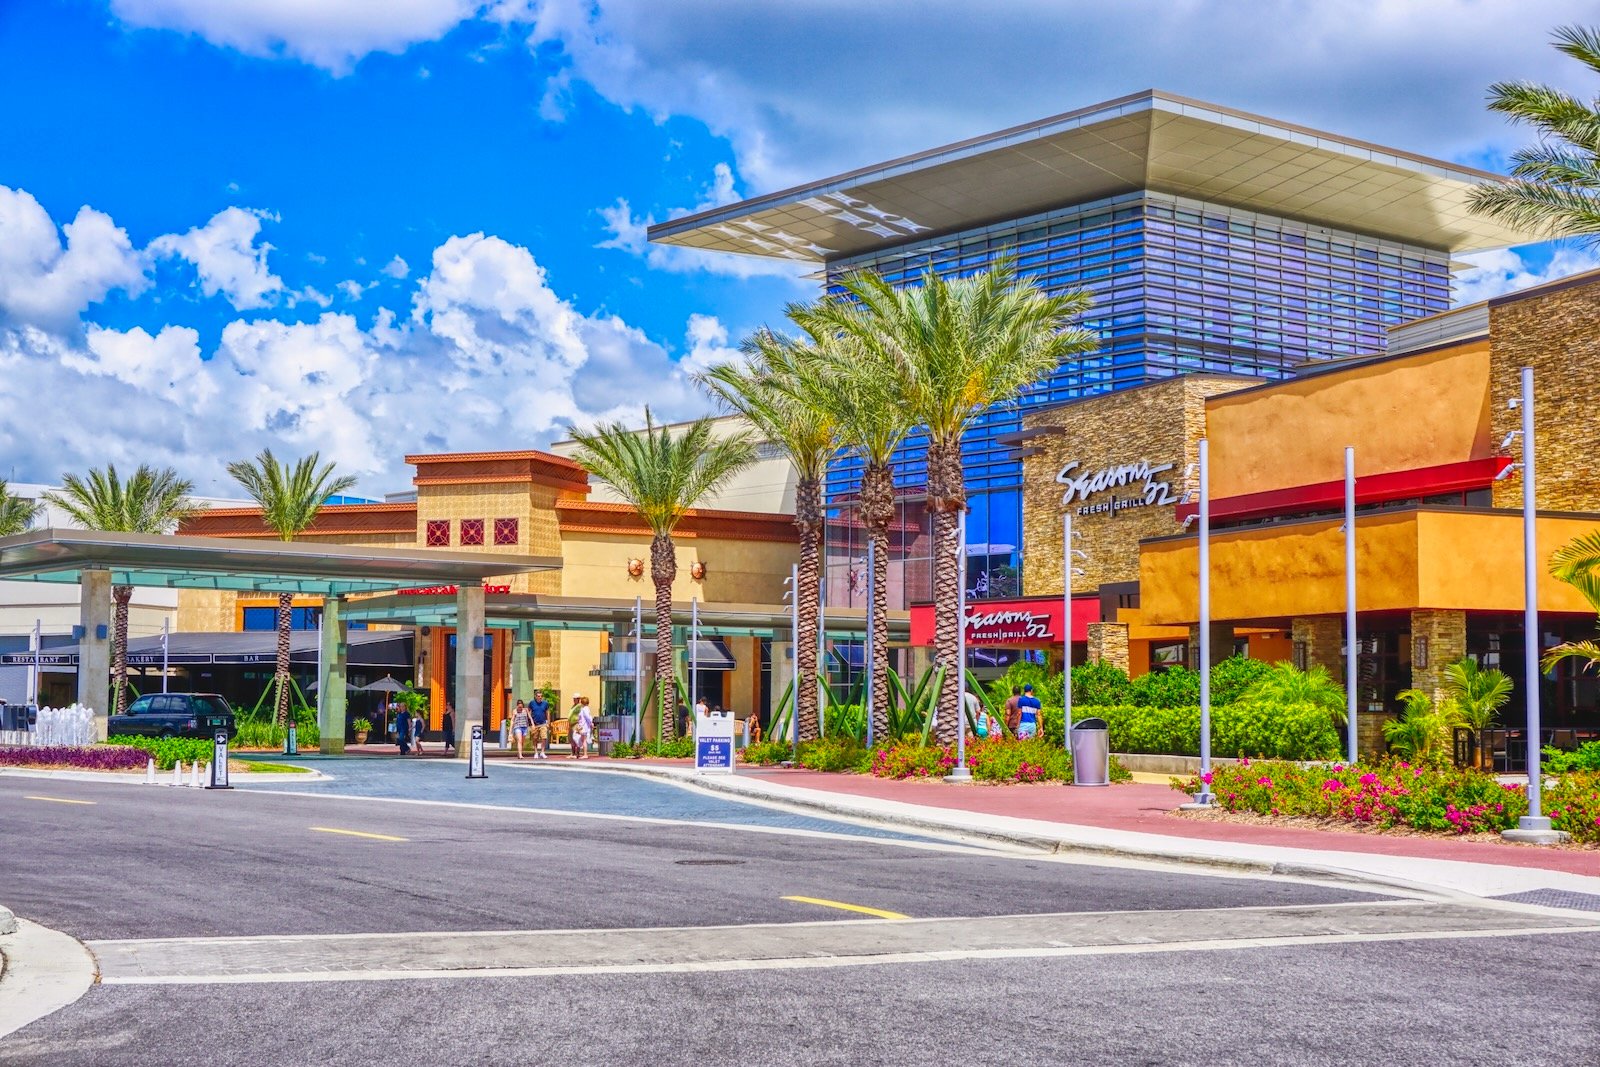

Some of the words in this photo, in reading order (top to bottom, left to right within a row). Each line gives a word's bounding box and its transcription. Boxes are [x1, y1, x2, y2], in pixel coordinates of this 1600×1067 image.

[1056, 459, 1158, 505] Seasons
[1143, 464, 1178, 506] 52
[1077, 502, 1109, 516] FRESH
[1114, 499, 1145, 510] GRILL
[1026, 614, 1054, 639] 52
